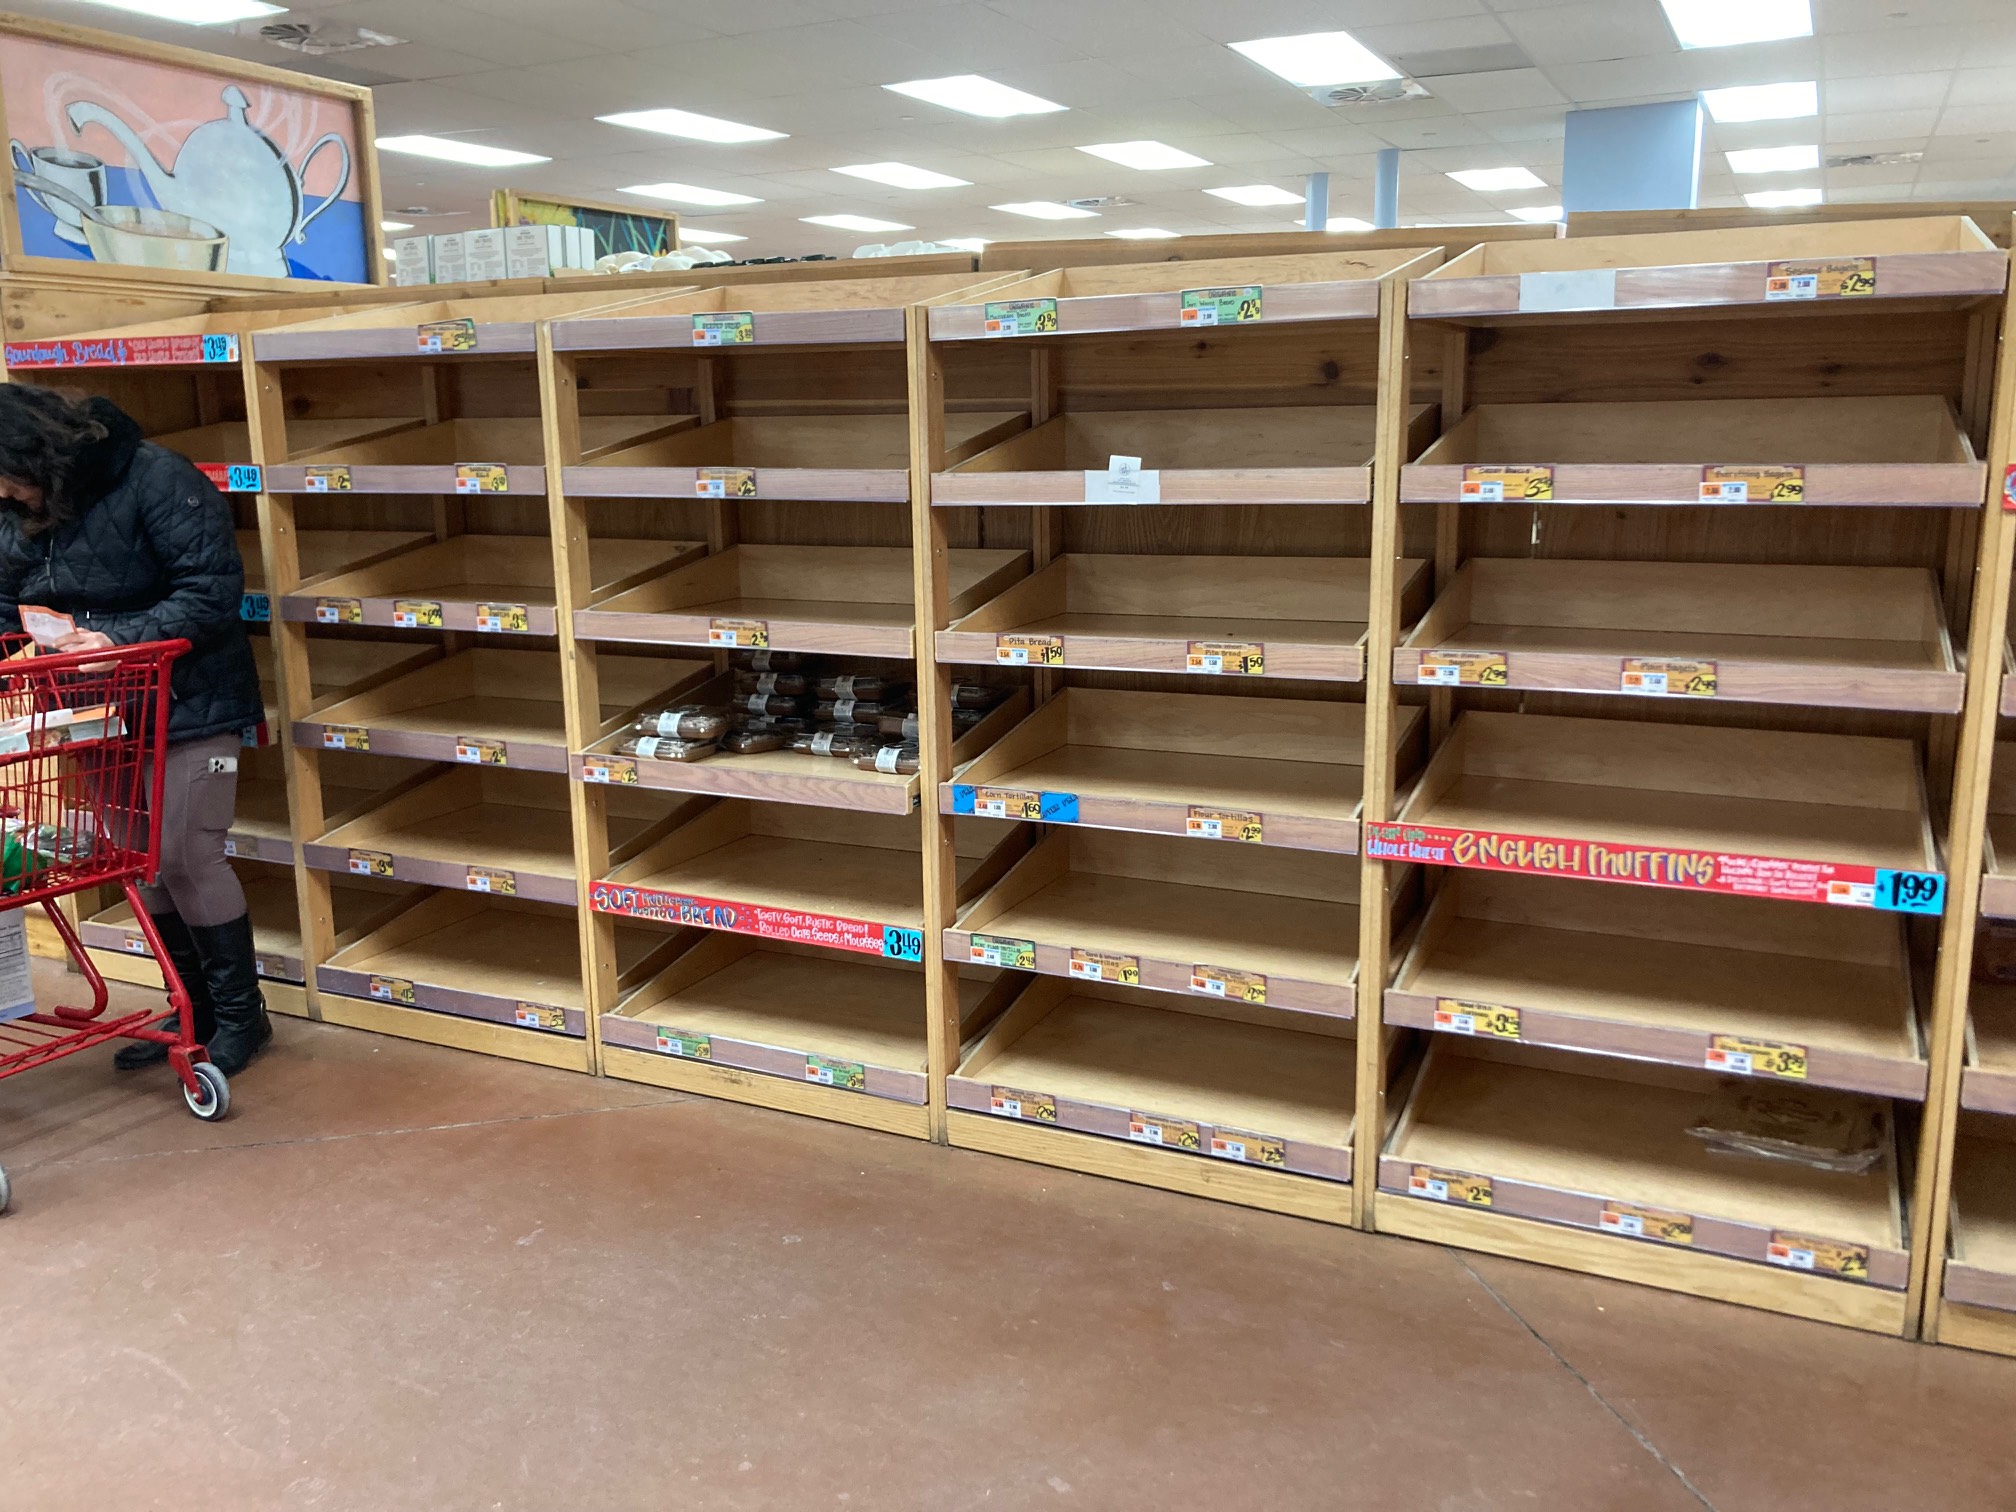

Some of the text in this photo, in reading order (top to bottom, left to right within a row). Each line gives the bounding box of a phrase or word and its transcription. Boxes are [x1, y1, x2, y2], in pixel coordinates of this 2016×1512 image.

[73, 340, 118, 365] Bread
[1008, 637, 1052, 646] Pita Bread
[1005, 792, 1034, 801] Tortillas
[1193, 810, 1254, 823] Flour Tortillas
[1367, 838, 1408, 857] WHOLE
[1451, 832, 1582, 872] ENGLISH
[1586, 844, 1715, 885] MUFFINS
[594, 886, 639, 911] SOFT
[680, 906, 738, 929] BREAD
[806, 917, 835, 931] RUSTIC
[836, 920, 868, 937] BREAD!
[759, 922, 791, 937] ROLLED
[844, 932, 884, 952] MOLASSES
